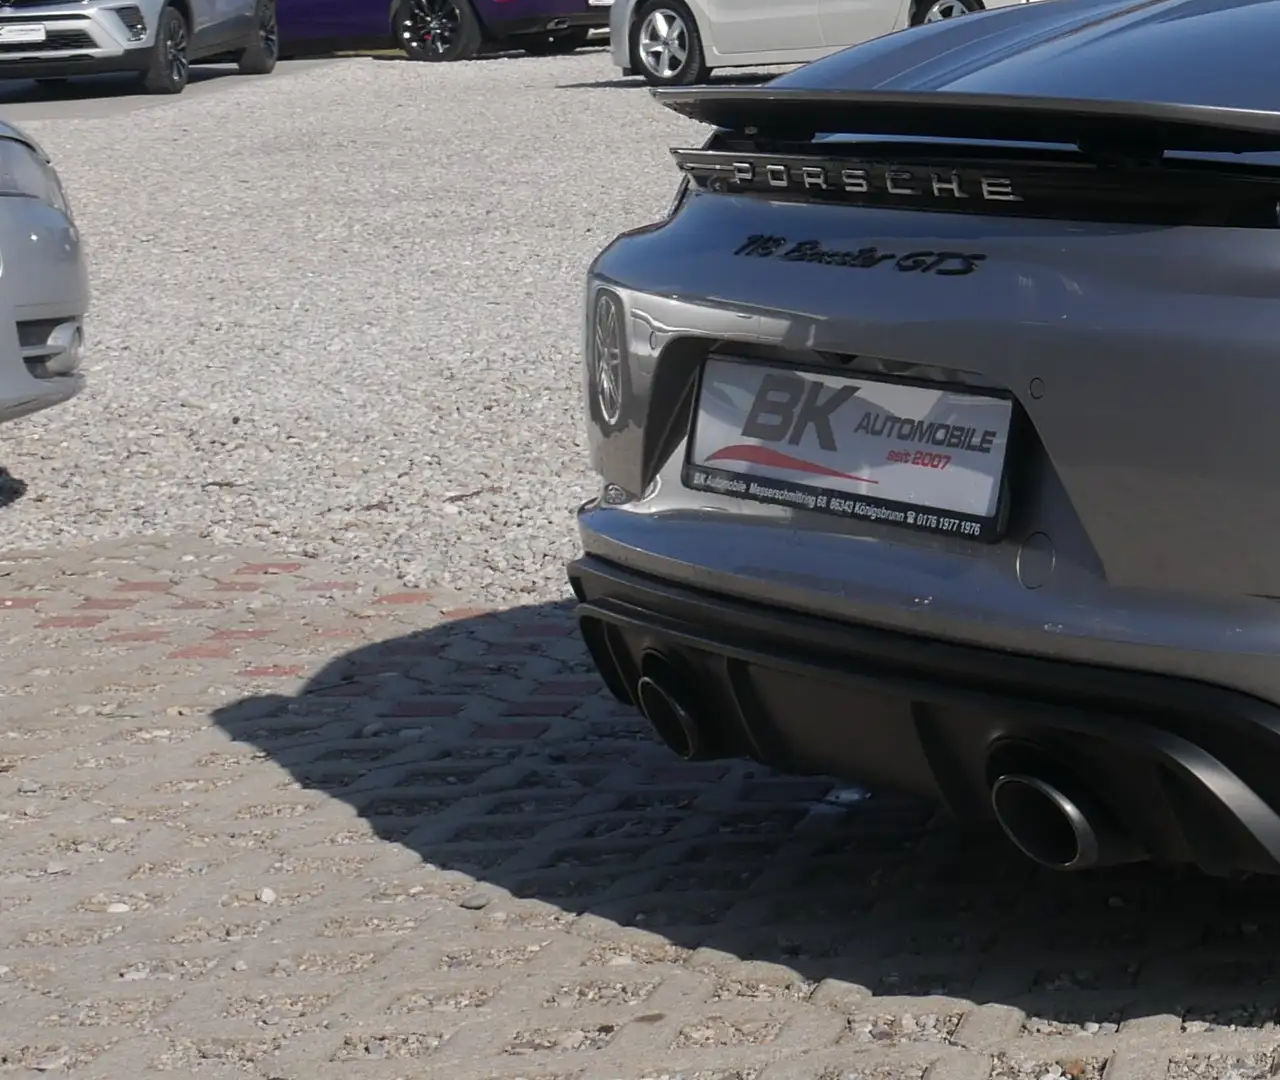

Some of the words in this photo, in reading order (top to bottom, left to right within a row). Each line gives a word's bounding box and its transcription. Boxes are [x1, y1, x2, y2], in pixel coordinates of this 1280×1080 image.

[732, 162, 1023, 202] PORSCHE
[779, 239, 895, 269] Boxster
[895, 251, 987, 276] GTS
[741, 373, 862, 451] BK
[853, 411, 998, 454] AUTOMOBILE
[886, 449, 911, 465] seit
[912, 451, 952, 471] 2007
[693, 472, 706, 486] BK
[706, 474, 746, 493] Automobile
[749, 483, 816, 509] Messerschmittring
[816, 496, 827, 508] 68
[829, 497, 854, 513] 86343
[854, 501, 905, 522] Königsbrunn
[916, 512, 937, 528] 0176
[938, 517, 959, 532] 1977
[960, 520, 981, 536] 1976
